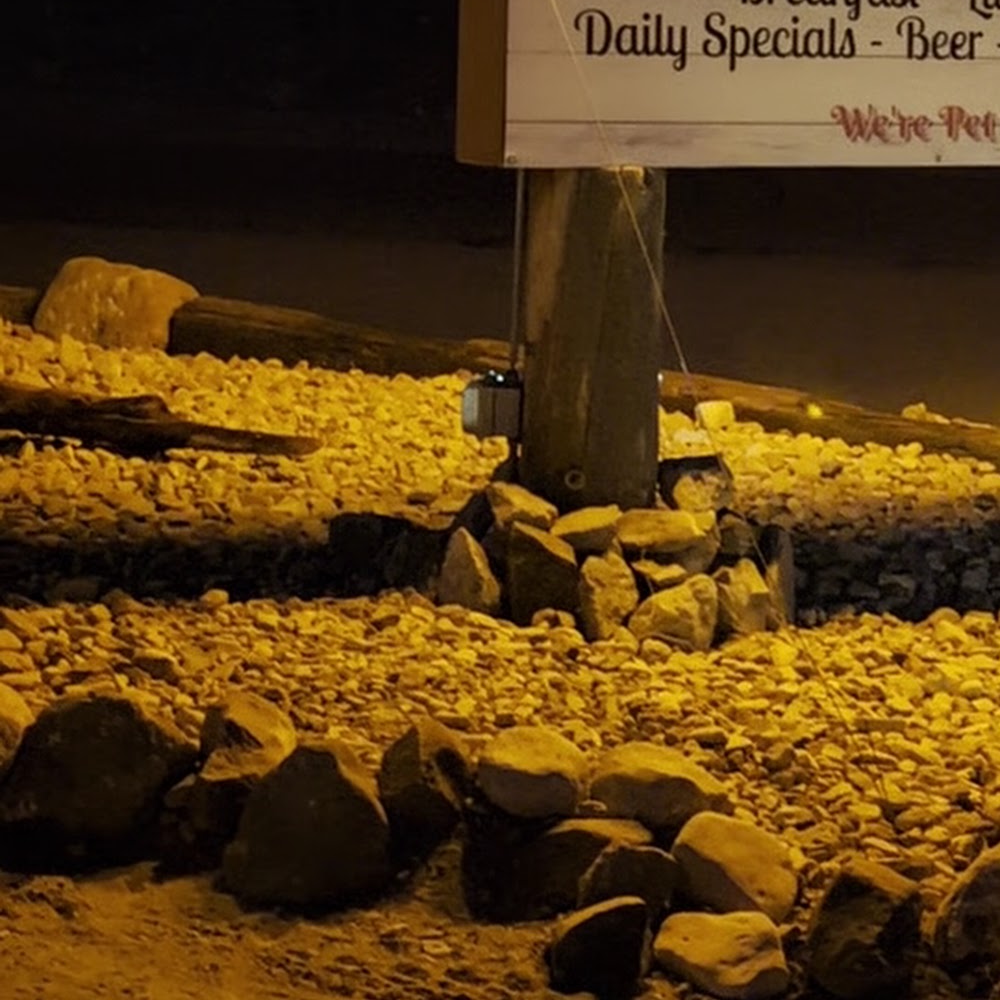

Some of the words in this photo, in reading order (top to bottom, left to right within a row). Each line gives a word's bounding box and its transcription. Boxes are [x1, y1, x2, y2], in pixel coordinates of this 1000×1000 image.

[574, 8, 688, 72] Daily
[702, 11, 857, 72] Specials
[897, 15, 984, 60] Beer
[830, 104, 933, 143] We're
[938, 105, 998, 142] Pet
